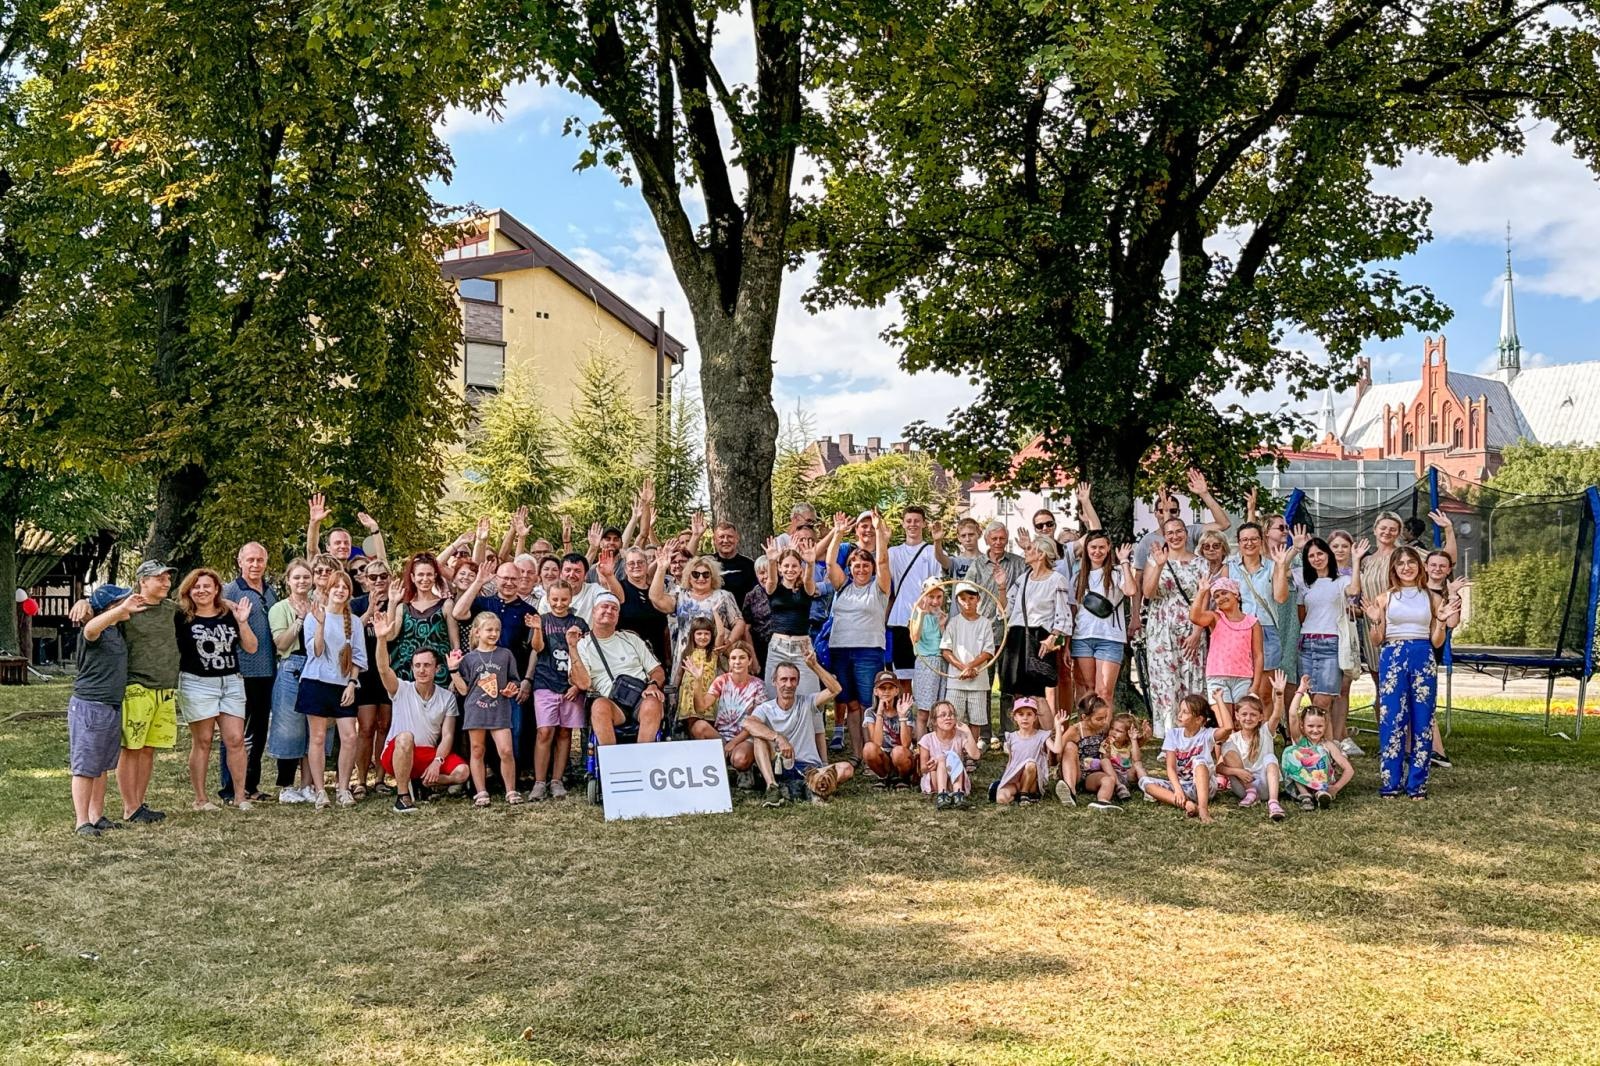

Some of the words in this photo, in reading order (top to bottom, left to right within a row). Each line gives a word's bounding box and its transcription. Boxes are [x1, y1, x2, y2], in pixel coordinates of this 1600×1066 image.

[191, 624, 238, 641] SMILE
[196, 636, 234, 659] ON
[200, 655, 236, 670] YOU
[649, 765, 720, 791] GCLS
